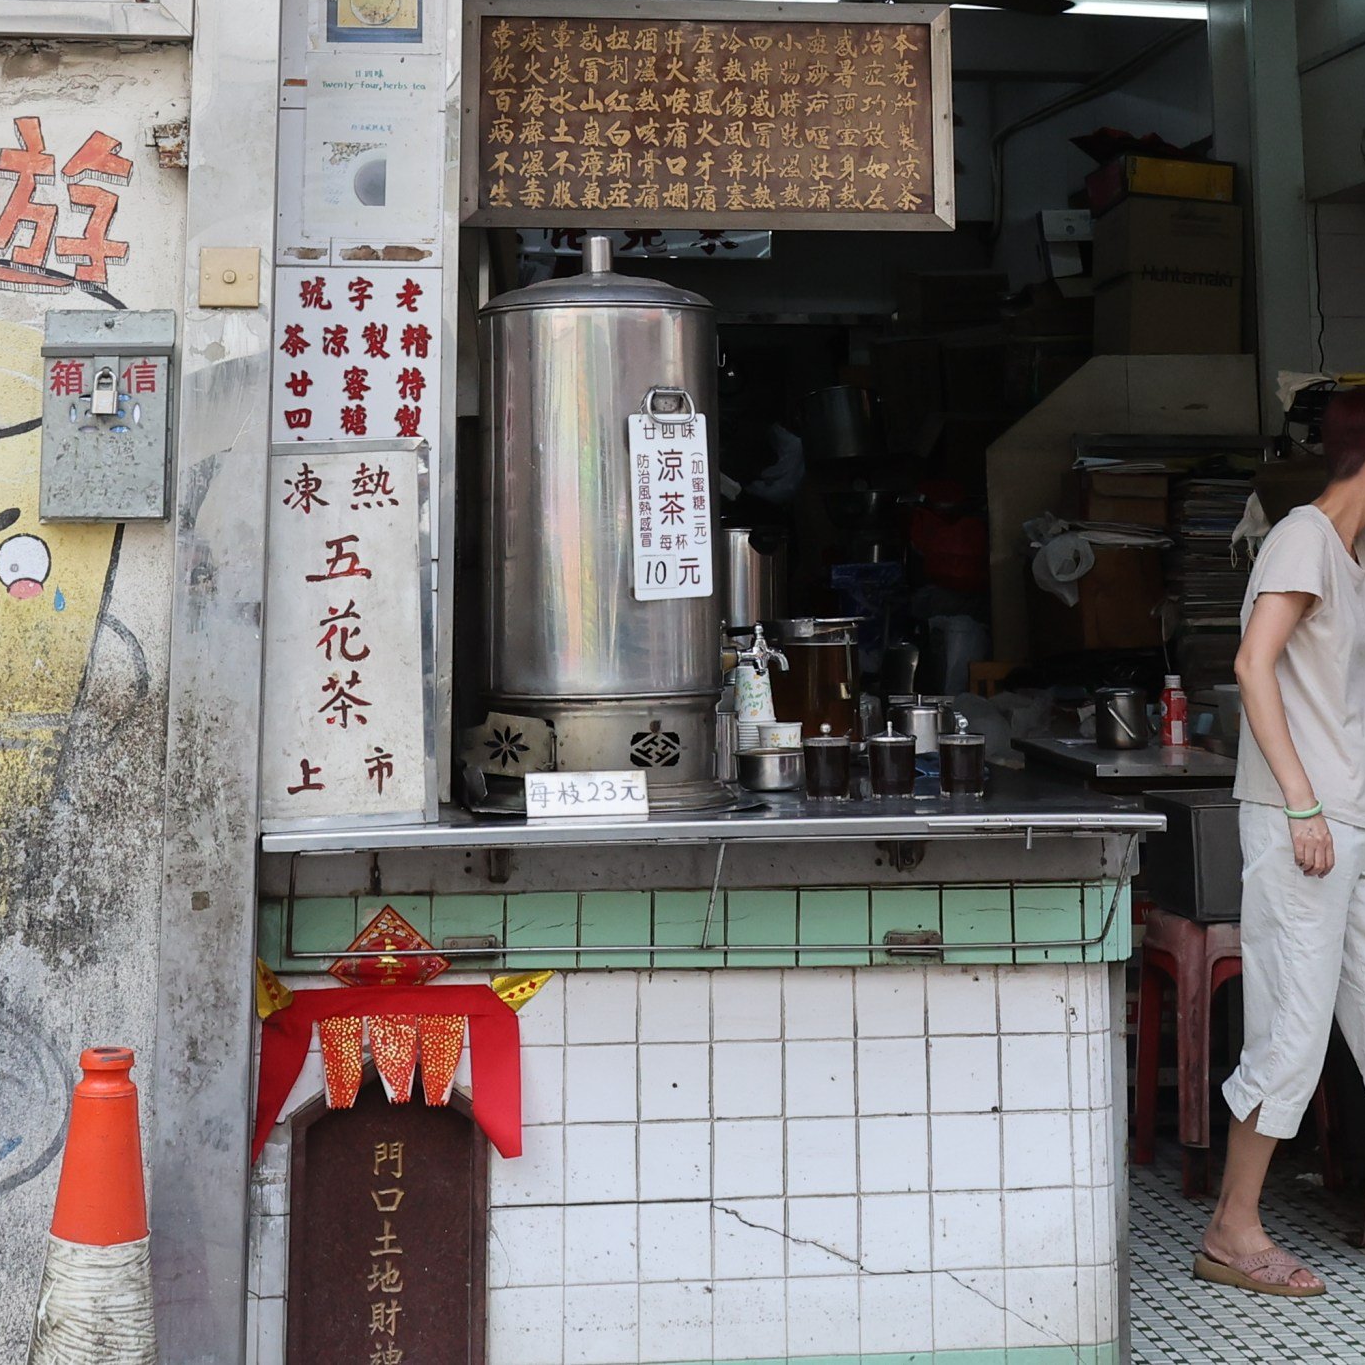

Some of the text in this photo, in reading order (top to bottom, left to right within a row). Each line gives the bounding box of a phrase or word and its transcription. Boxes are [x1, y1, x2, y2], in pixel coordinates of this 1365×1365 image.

[383, 81, 408, 89] herbs
[637, 454, 652, 548] 防治風熱感冒
[657, 448, 685, 526] 涼茶
[659, 534, 688, 551] 每杯
[305, 534, 373, 729] 五花茶
